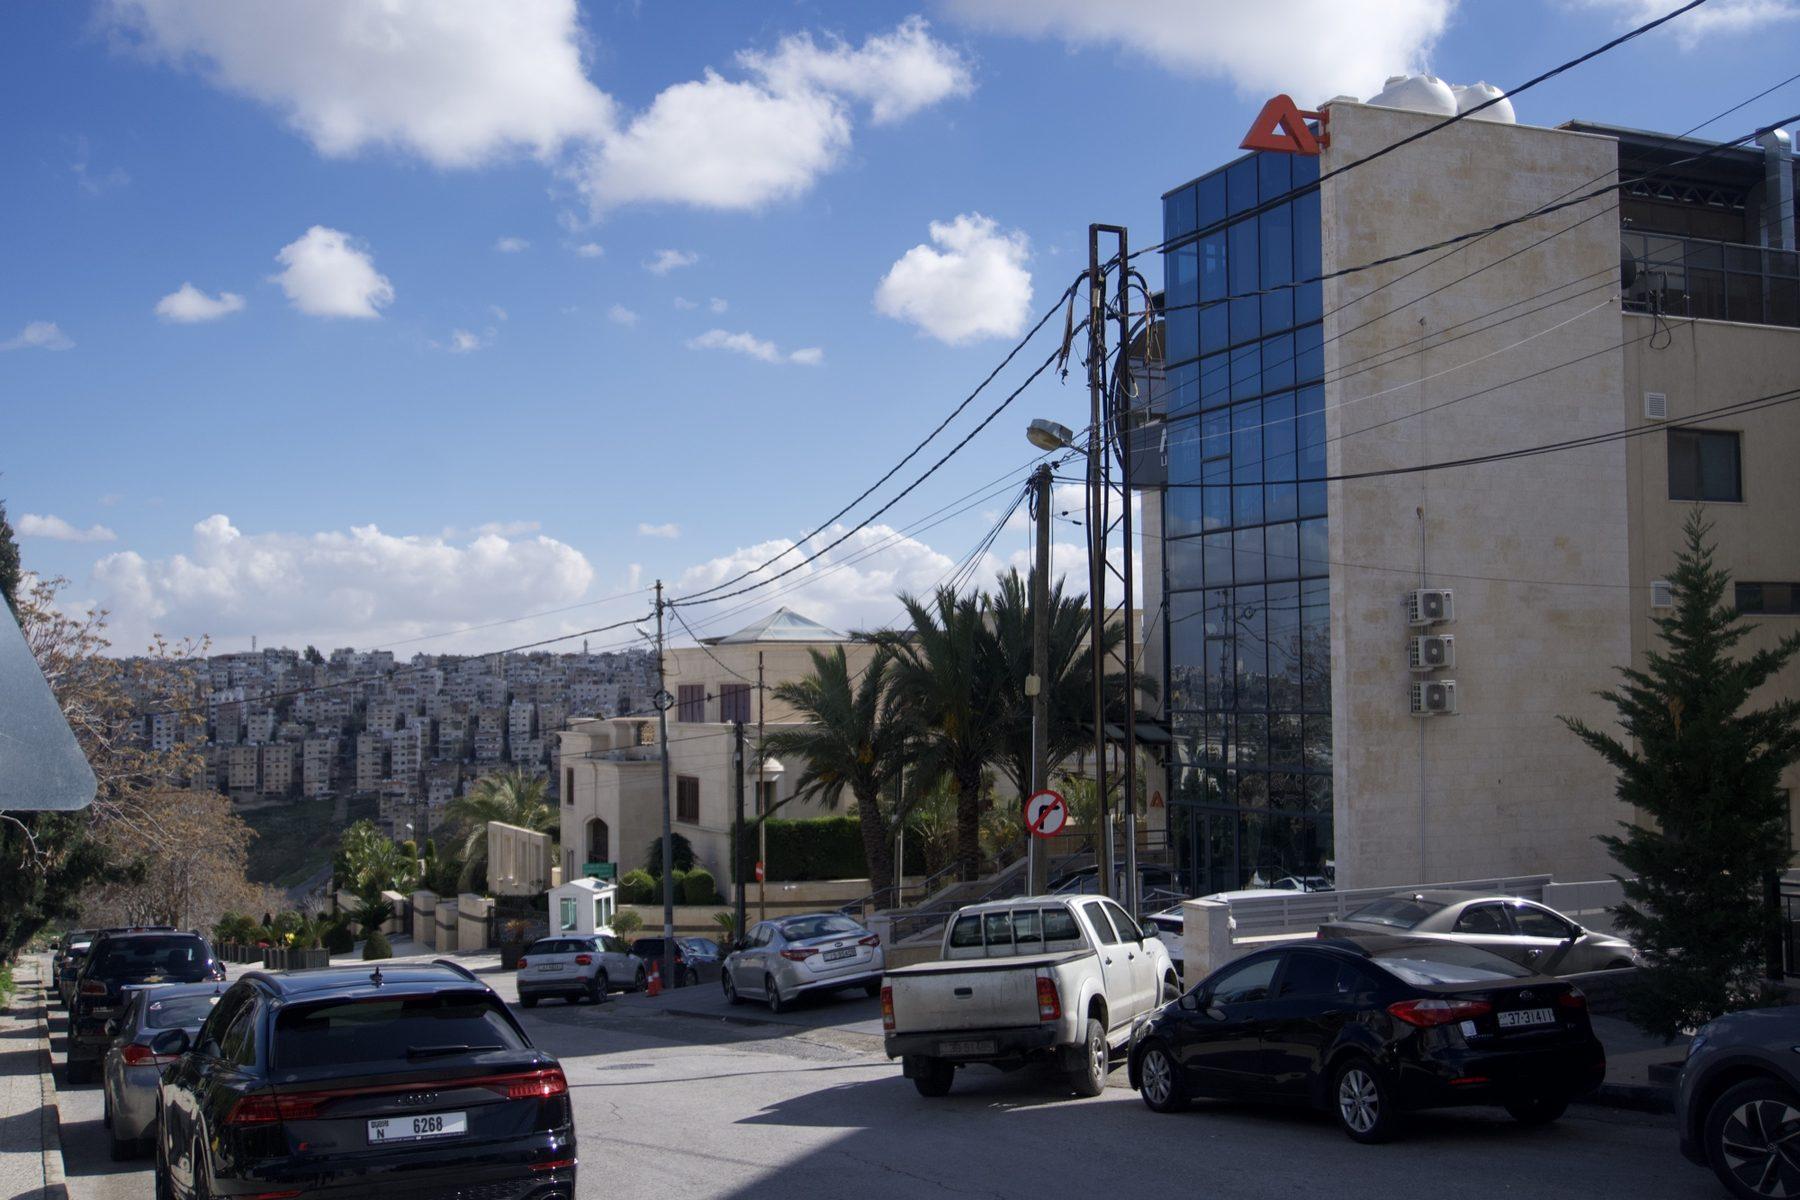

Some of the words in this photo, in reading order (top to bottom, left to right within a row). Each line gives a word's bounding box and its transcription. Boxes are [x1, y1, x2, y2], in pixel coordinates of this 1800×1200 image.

[1507, 1008, 1553, 1025] 37-31411
[376, 1128, 385, 1139] N
[413, 1116, 443, 1134] 6268
